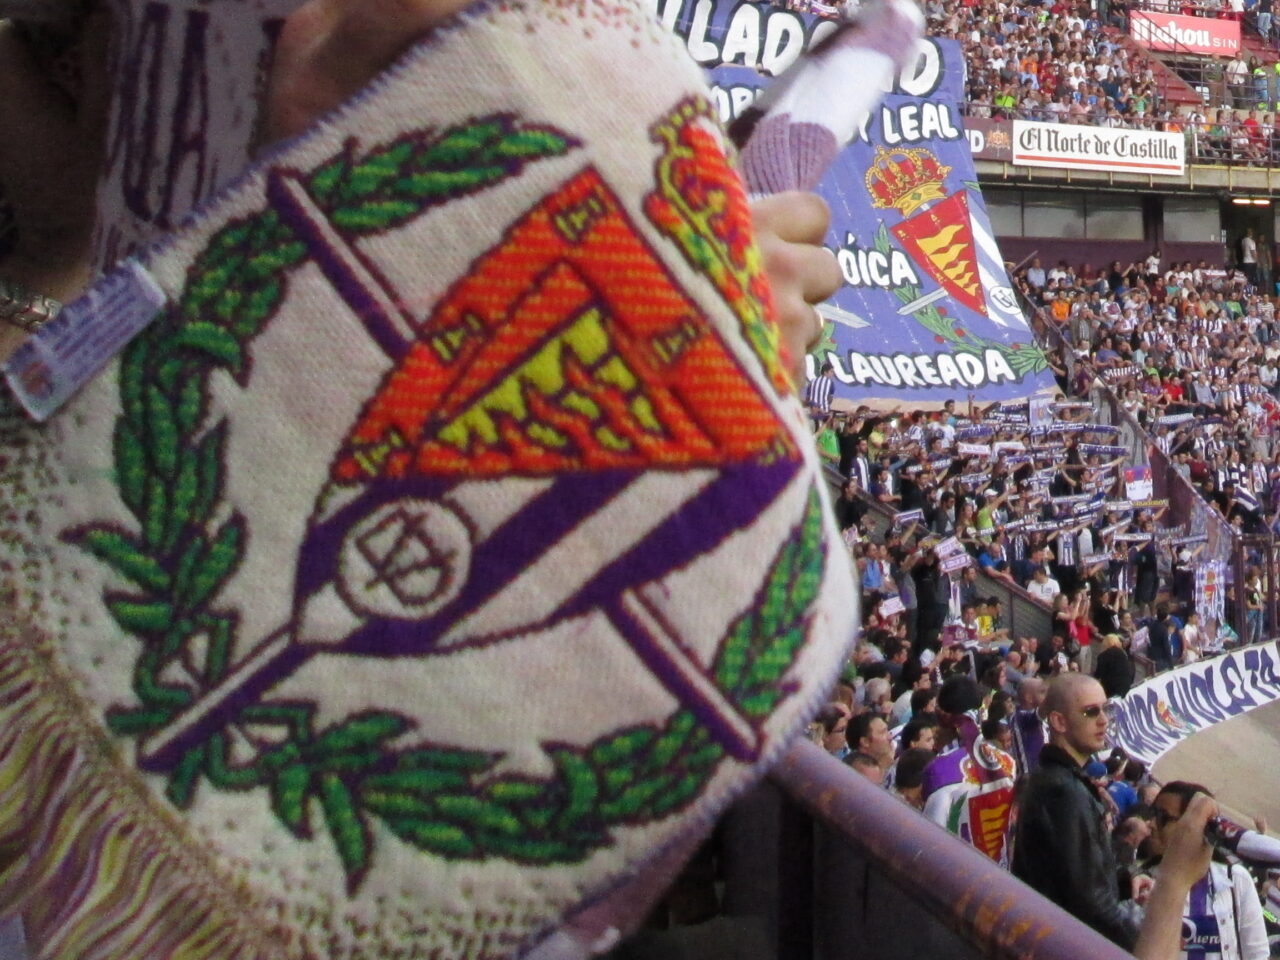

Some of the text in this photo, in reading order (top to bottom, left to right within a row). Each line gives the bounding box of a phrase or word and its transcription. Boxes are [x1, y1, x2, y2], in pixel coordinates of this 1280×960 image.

[1131, 17, 1238, 49] Mahou SIN
[882, 102, 959, 142] LEAL
[1018, 127, 1178, 161] El Norte de Castilla
[826, 348, 1017, 389] LAUREADA
